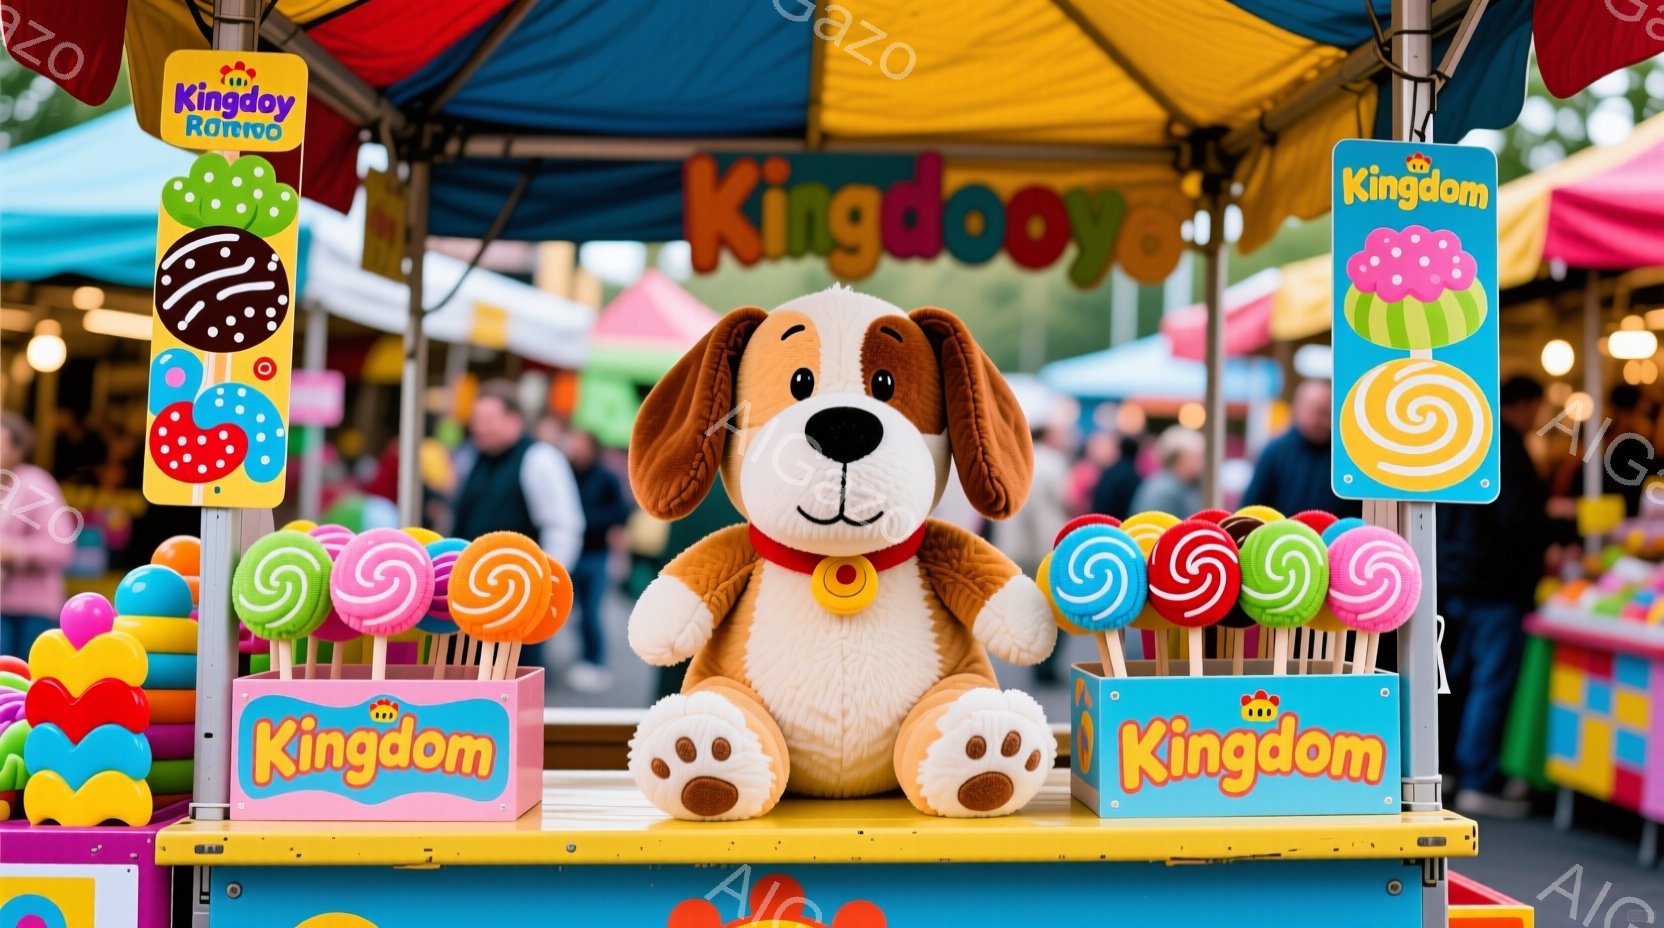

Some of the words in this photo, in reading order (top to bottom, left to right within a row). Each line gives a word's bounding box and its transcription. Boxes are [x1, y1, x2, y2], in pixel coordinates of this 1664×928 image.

[174, 82, 296, 123] Kingdoy
[1342, 164, 1489, 211] Kingdom
[253, 713, 497, 790] Kingdom
[1118, 711, 1387, 798] Kingdom
